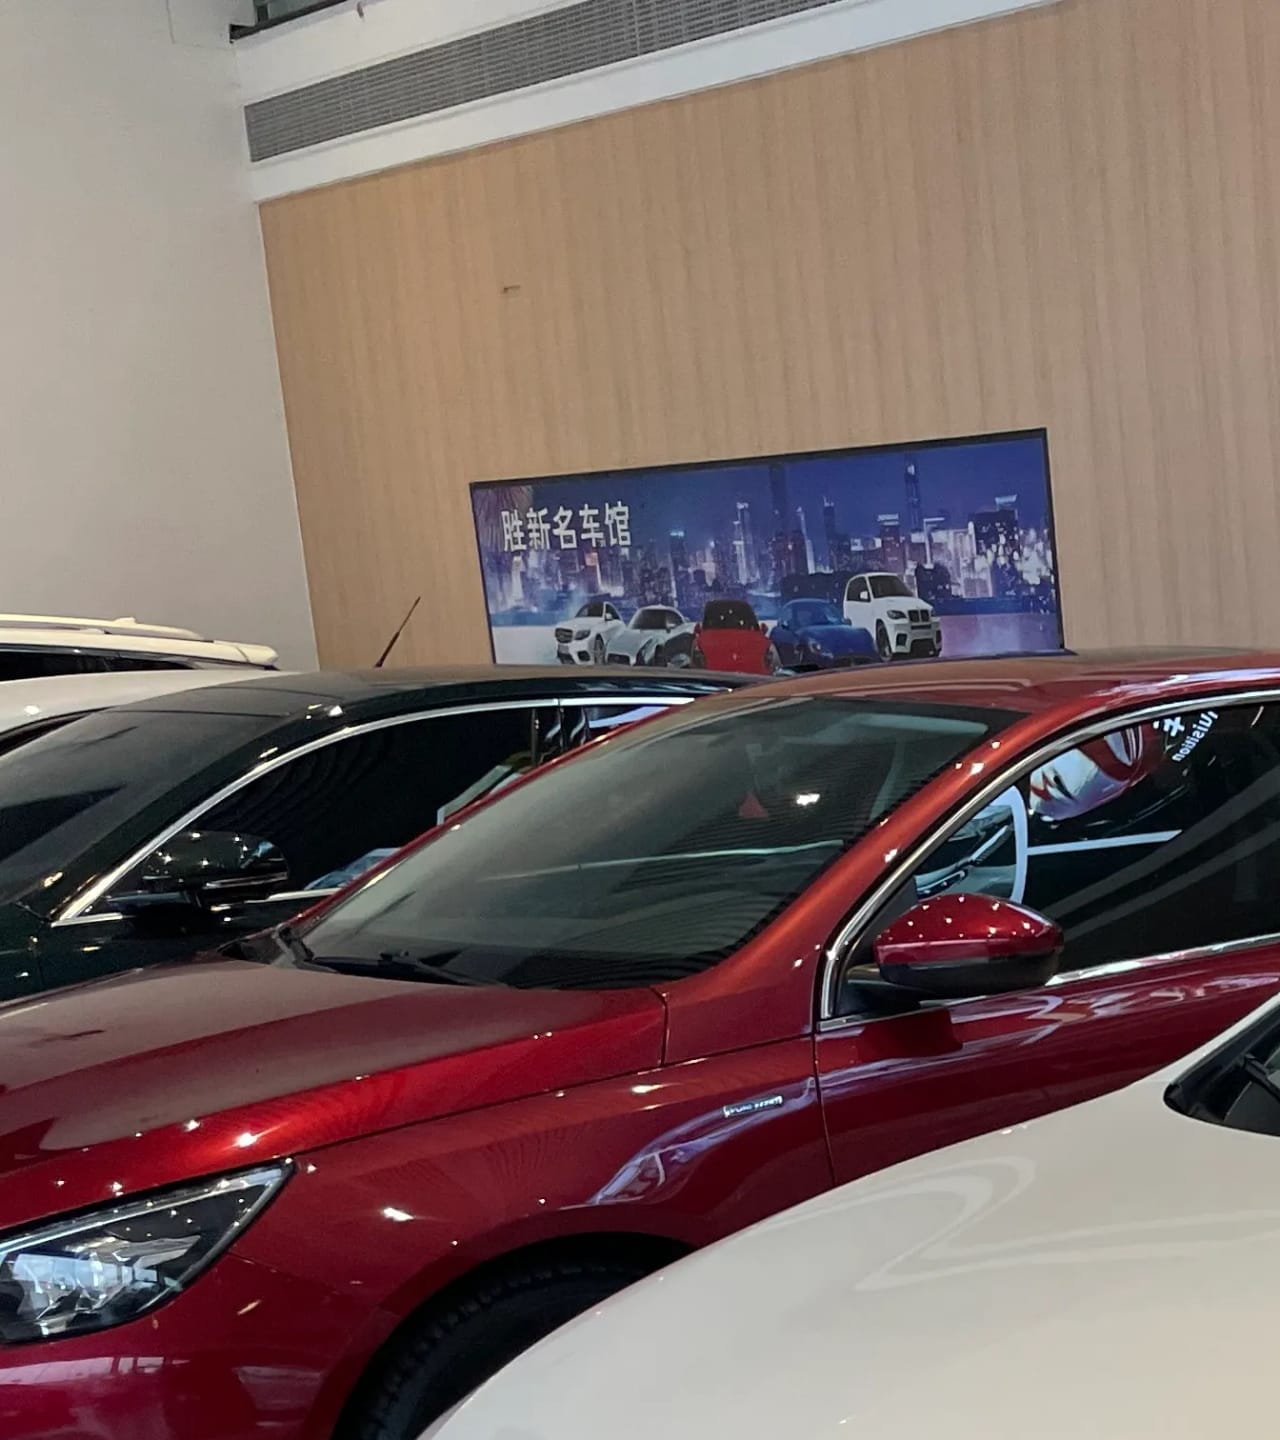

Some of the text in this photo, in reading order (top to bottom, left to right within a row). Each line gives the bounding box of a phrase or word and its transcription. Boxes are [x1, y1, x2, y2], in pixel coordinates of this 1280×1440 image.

[502, 500, 631, 553] 胜新名车馆
